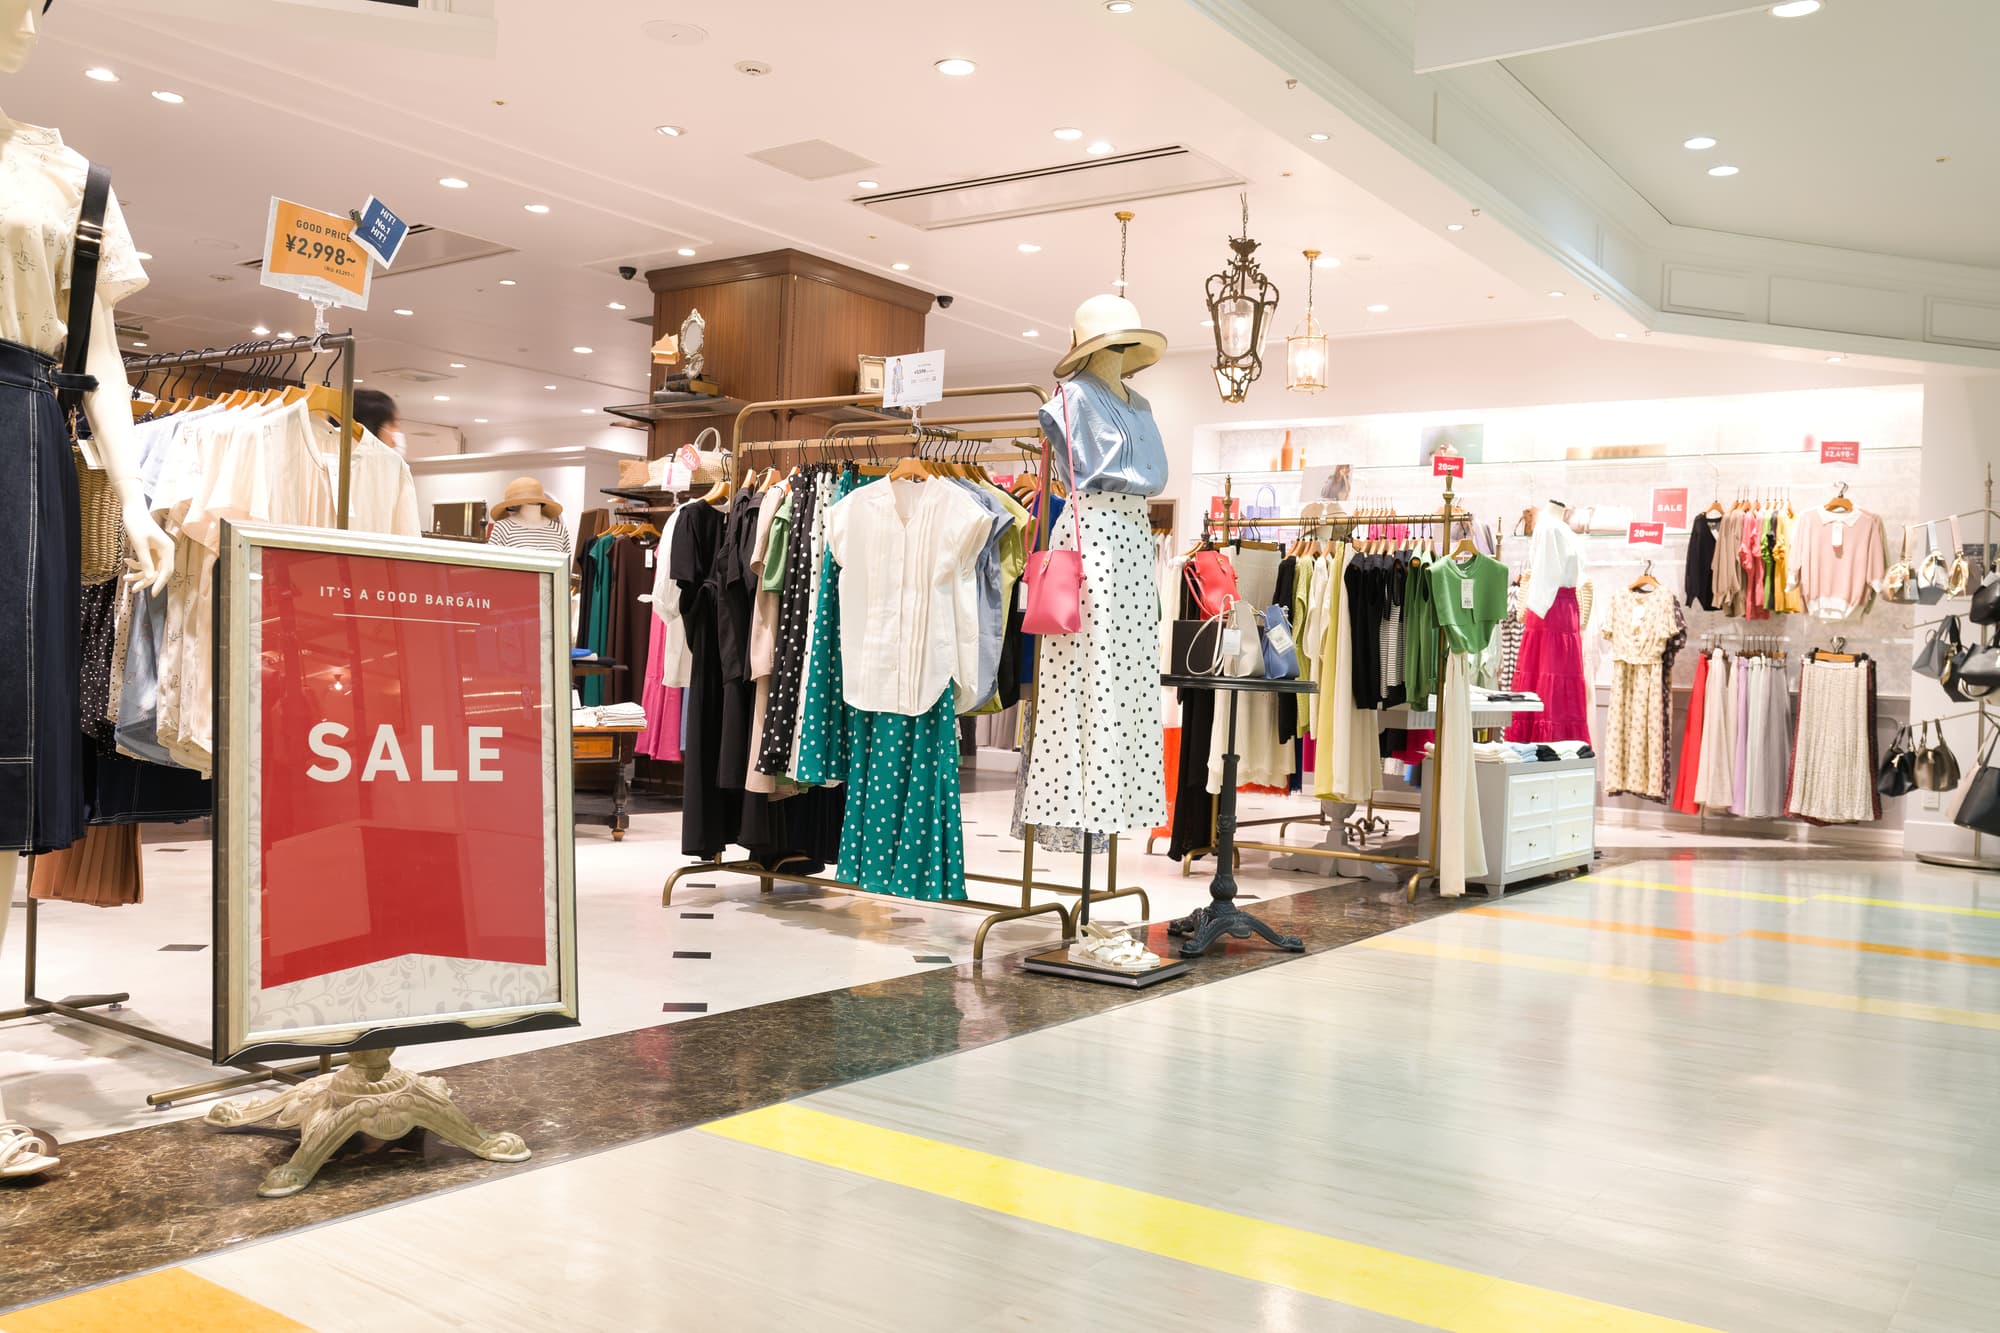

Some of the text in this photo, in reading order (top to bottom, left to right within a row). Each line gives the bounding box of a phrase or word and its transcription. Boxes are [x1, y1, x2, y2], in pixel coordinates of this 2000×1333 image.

[375, 217, 391, 234] No.1
[380, 208, 397, 225] HIT!
[296, 219, 323, 234] GOOD
[325, 228, 352, 242] PRICE
[370, 228, 387, 244] HIT!
[320, 586, 491, 609] IT'S A GOOD BARGAIN
[305, 722, 504, 782] SALE
